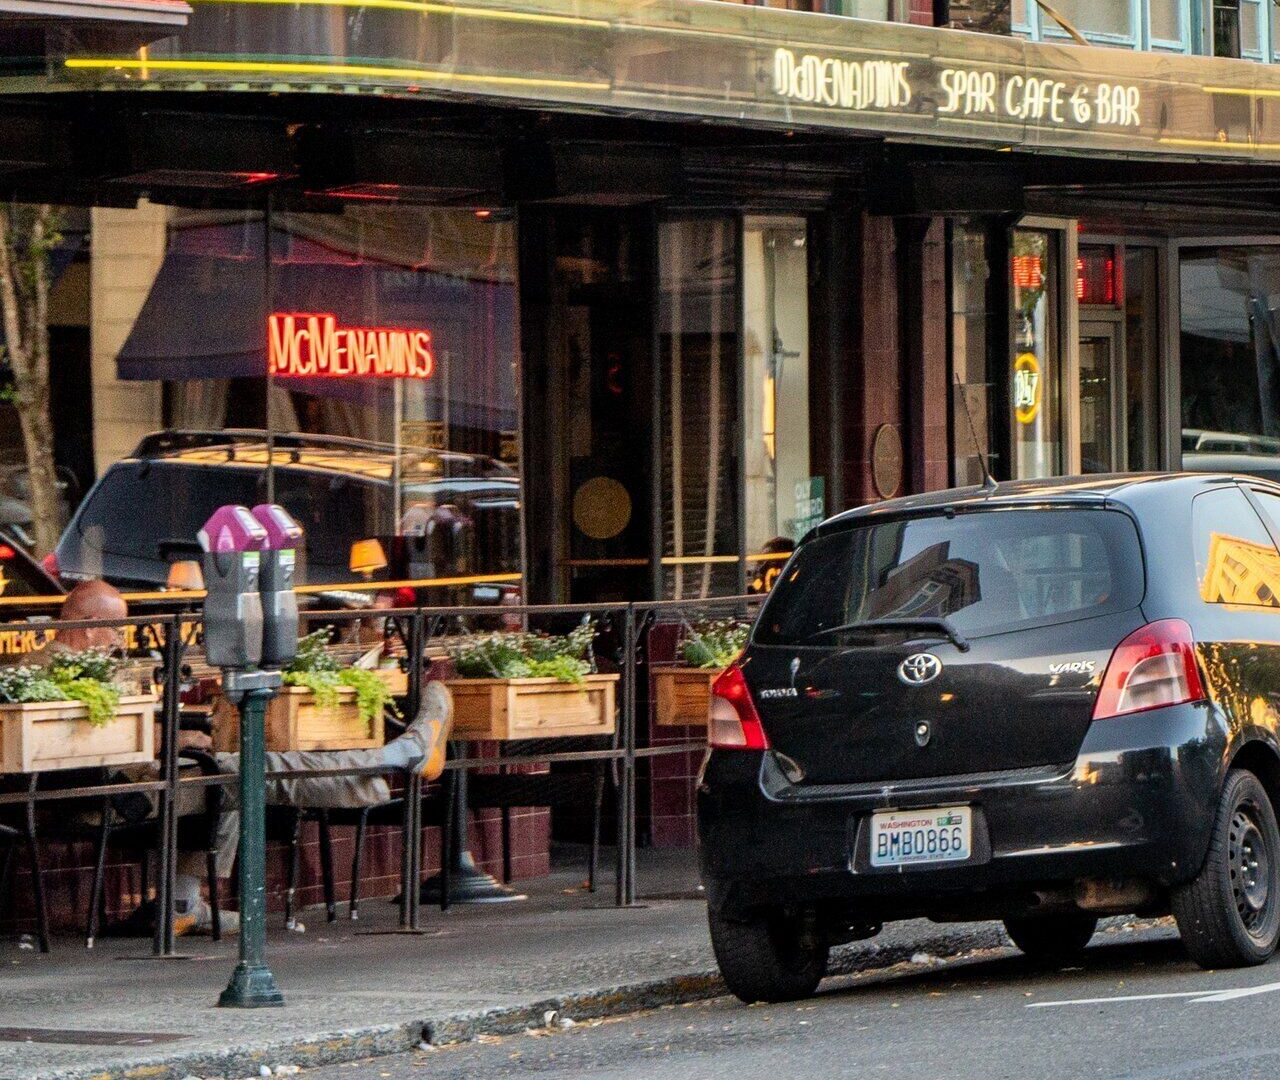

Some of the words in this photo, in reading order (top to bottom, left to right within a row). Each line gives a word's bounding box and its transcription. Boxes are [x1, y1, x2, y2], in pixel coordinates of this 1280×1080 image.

[936, 69, 996, 115] SPAR
[1004, 74, 1066, 124] CAFE
[1072, 80, 1091, 125] &
[1095, 82, 1141, 127] BAR
[1048, 660, 1095, 673] YARIS
[760, 687, 798, 699] TOYOTA
[880, 819, 932, 830] WASHINGTON
[878, 826, 962, 857] BMB0866
